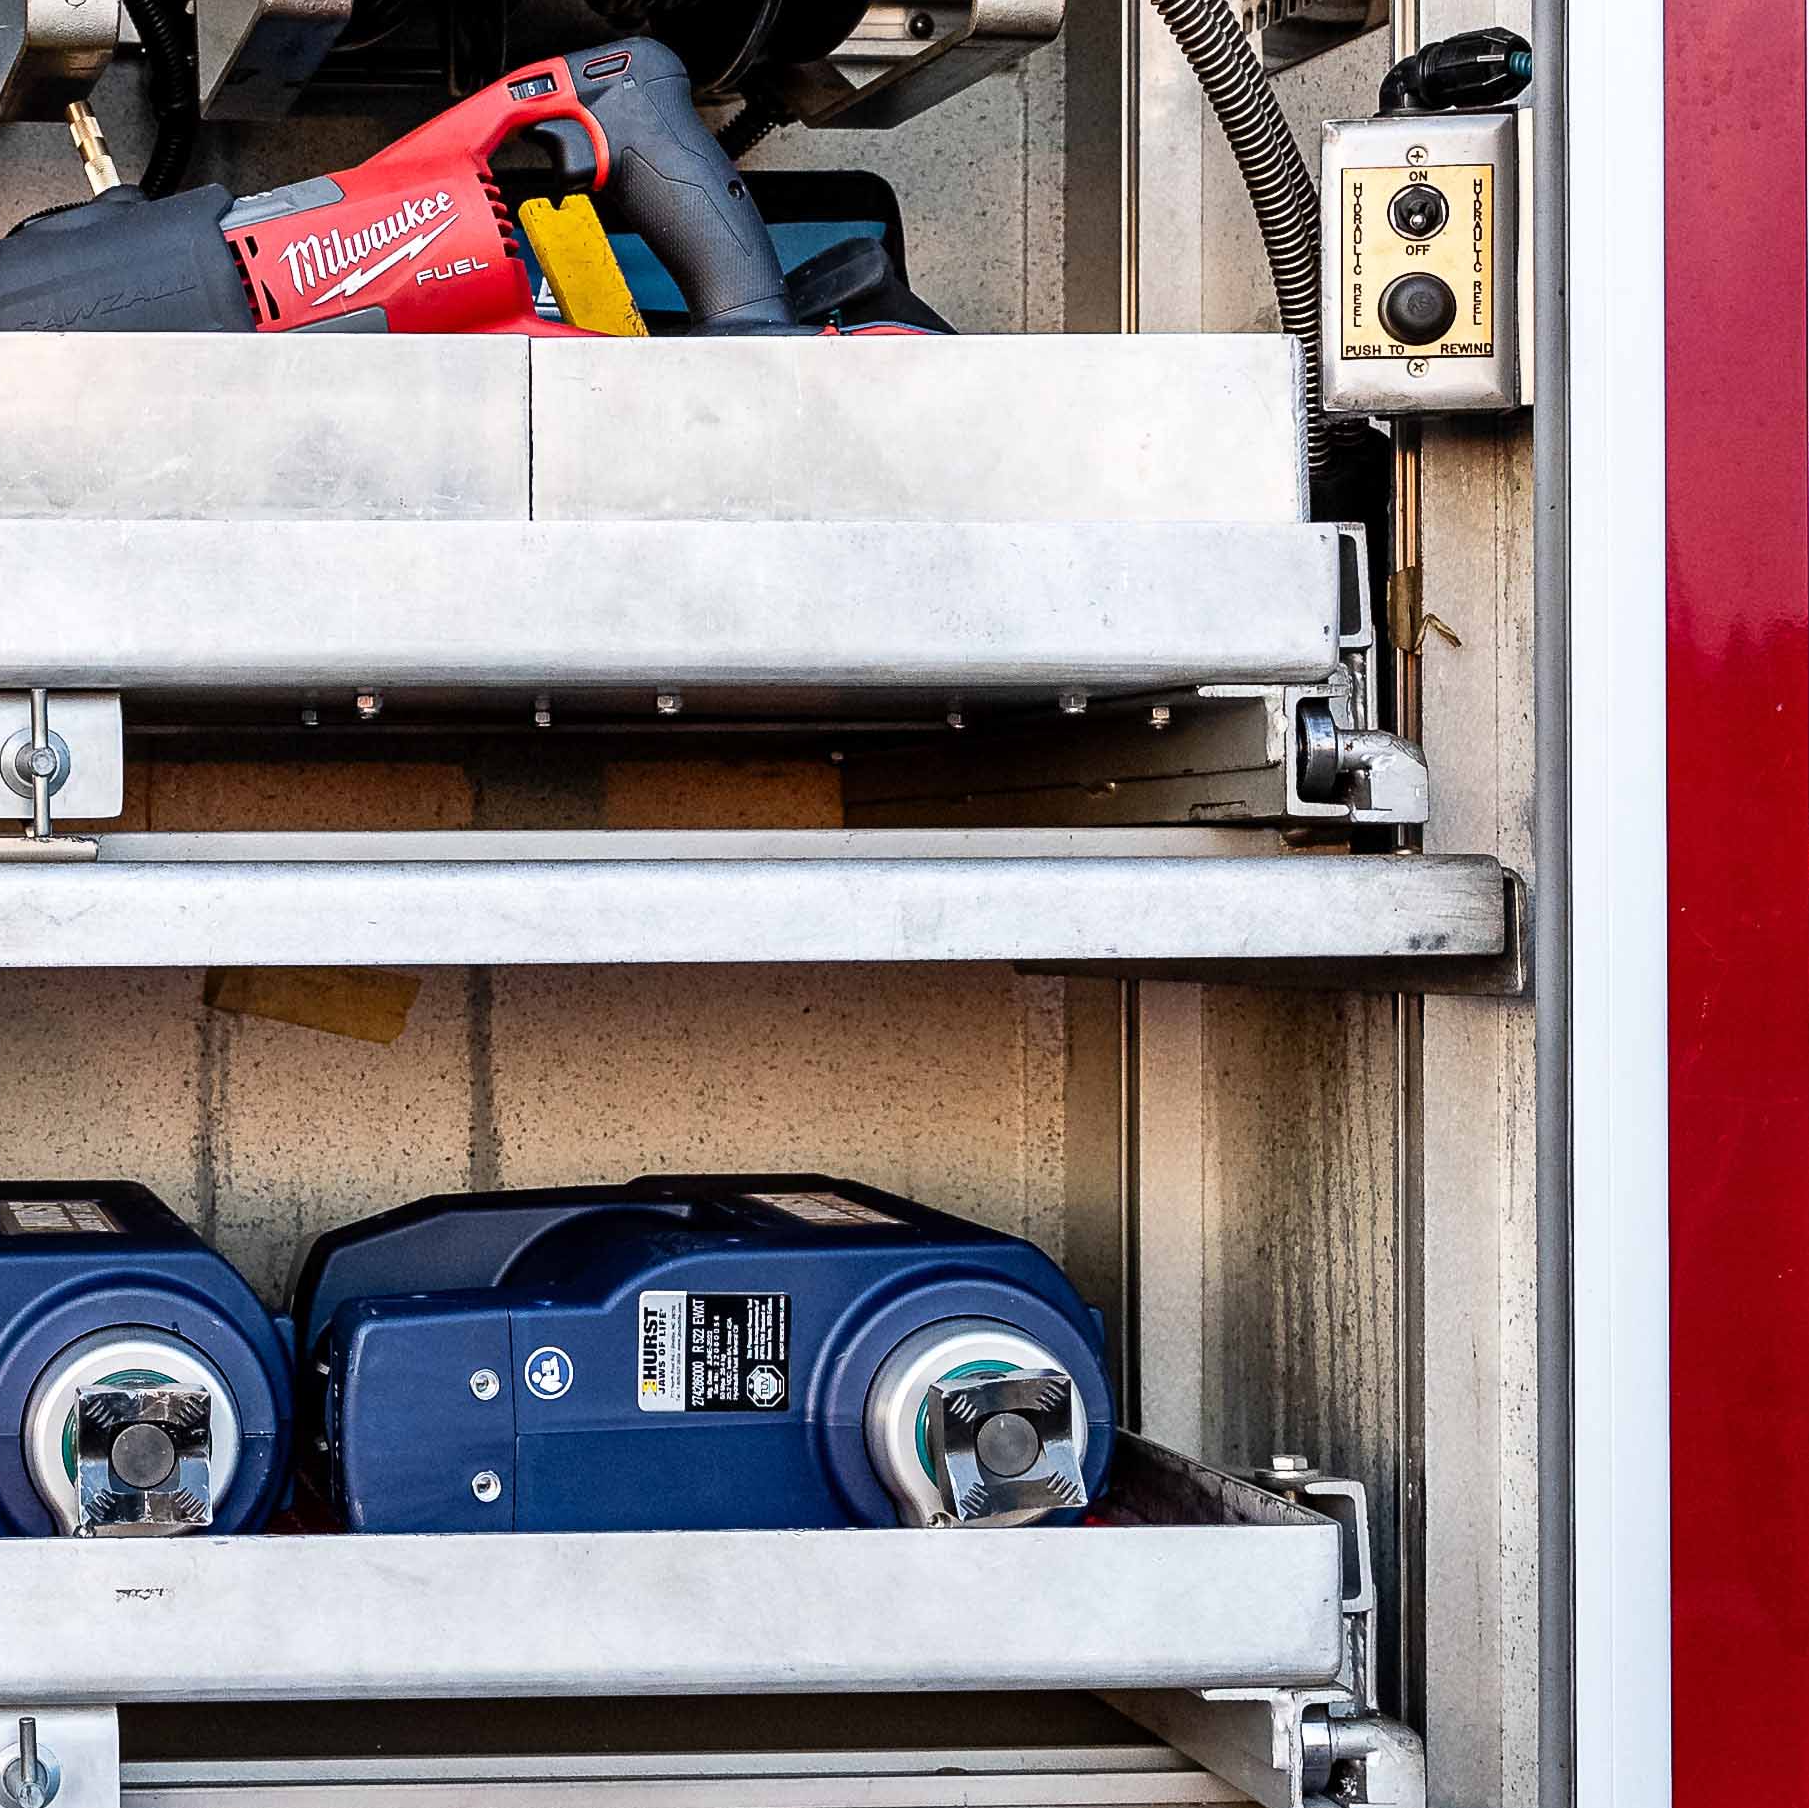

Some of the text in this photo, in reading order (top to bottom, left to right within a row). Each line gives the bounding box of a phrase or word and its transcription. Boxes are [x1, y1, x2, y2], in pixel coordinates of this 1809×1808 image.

[1409, 171, 1428, 182] ON
[277, 191, 456, 296] Milwaukee
[1353, 183, 1363, 328] HYDRAULIC REEL
[1406, 245, 1430, 256] OFF
[1473, 178, 1483, 326] HYDRAULIC REEL
[416, 257, 490, 286] FUEL
[1346, 343, 1493, 356] PUSH TO REWIND
[693, 1298, 704, 1324] EWXT
[643, 1307, 657, 1379] HURST
[659, 1342, 666, 1356] OF
[693, 1328, 704, 1343] 522
[658, 1361, 666, 1394] JAWS
